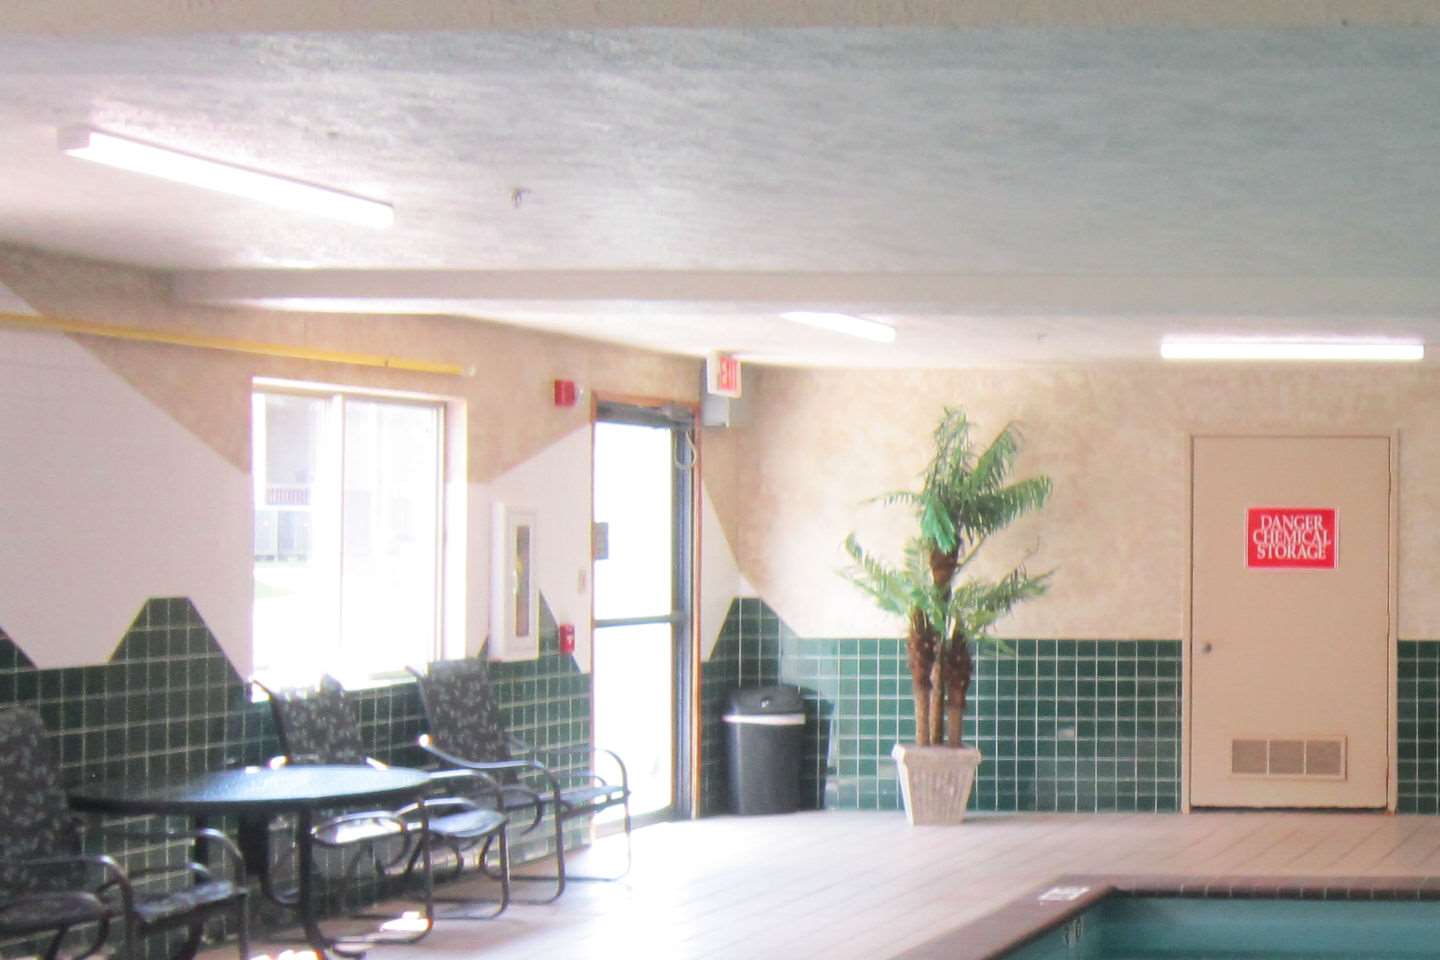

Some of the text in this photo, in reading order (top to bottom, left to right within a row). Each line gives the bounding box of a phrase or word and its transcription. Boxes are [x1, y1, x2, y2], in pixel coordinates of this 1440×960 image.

[1260, 514, 1324, 530] DANGER
[1252, 529, 1332, 545] CHEMICAL
[1256, 544, 1327, 560] STORAGE
